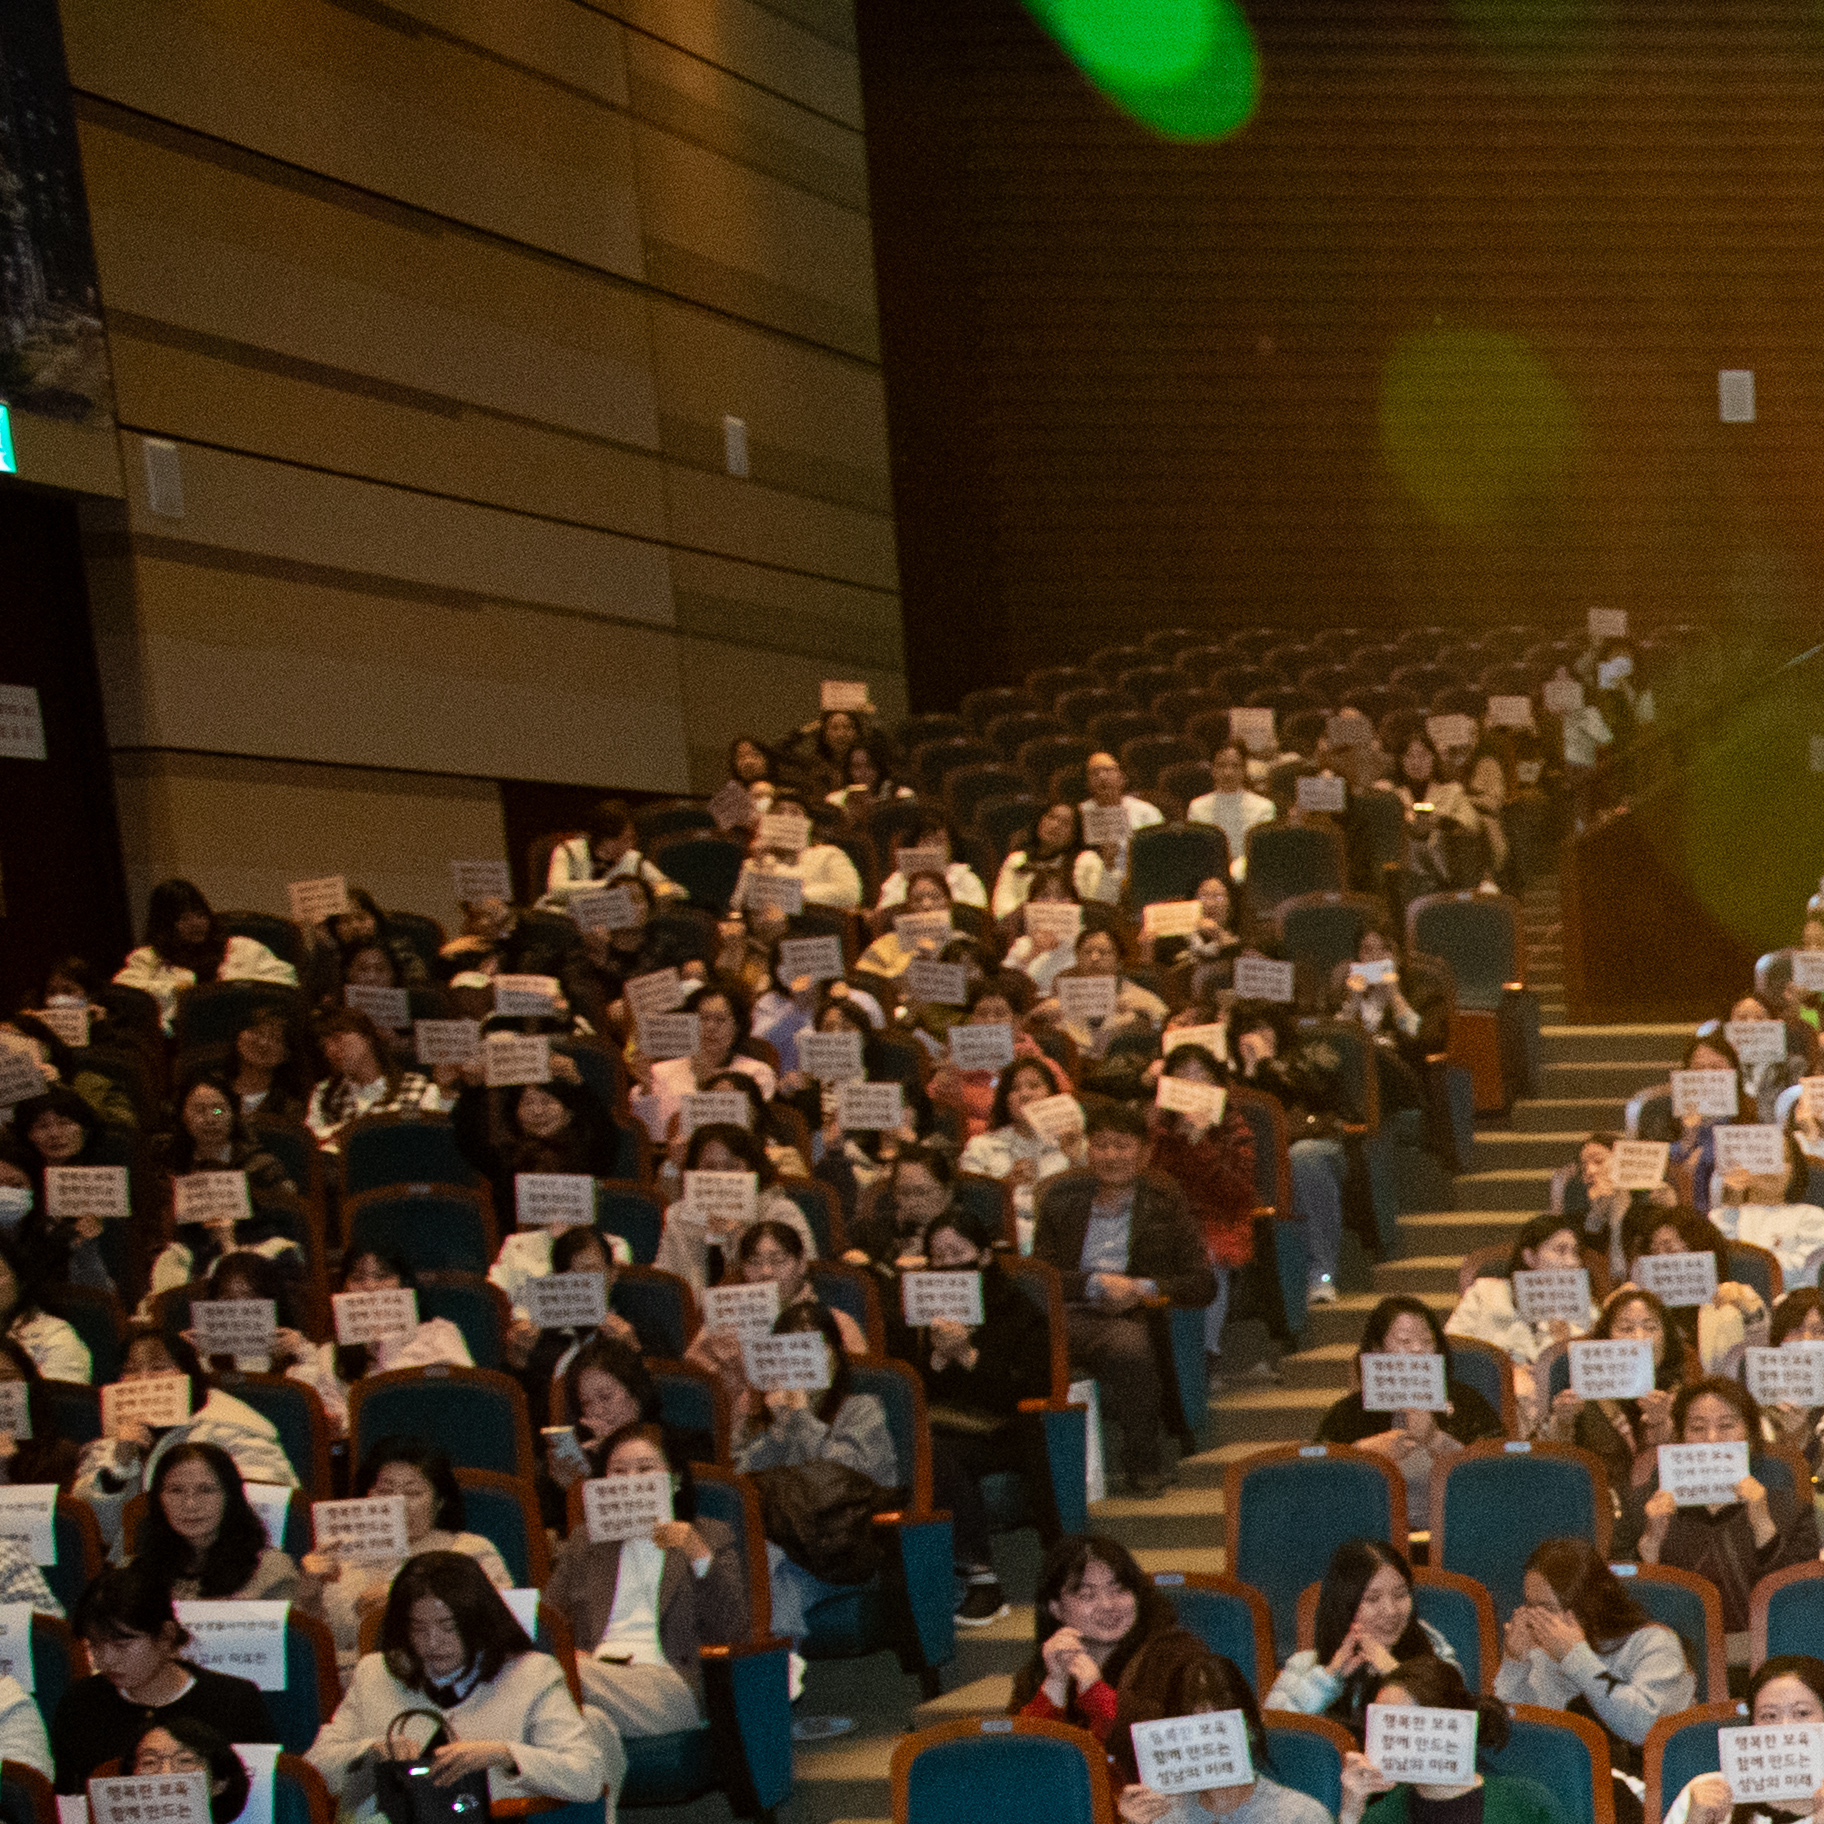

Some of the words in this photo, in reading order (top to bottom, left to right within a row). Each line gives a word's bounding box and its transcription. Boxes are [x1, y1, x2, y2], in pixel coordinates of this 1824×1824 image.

[1383, 1713, 1425, 1731] 행복한
[1431, 1717, 1458, 1733] 보육
[1382, 1734, 1410, 1750] 함께
[1415, 1737, 1458, 1754] 만드는
